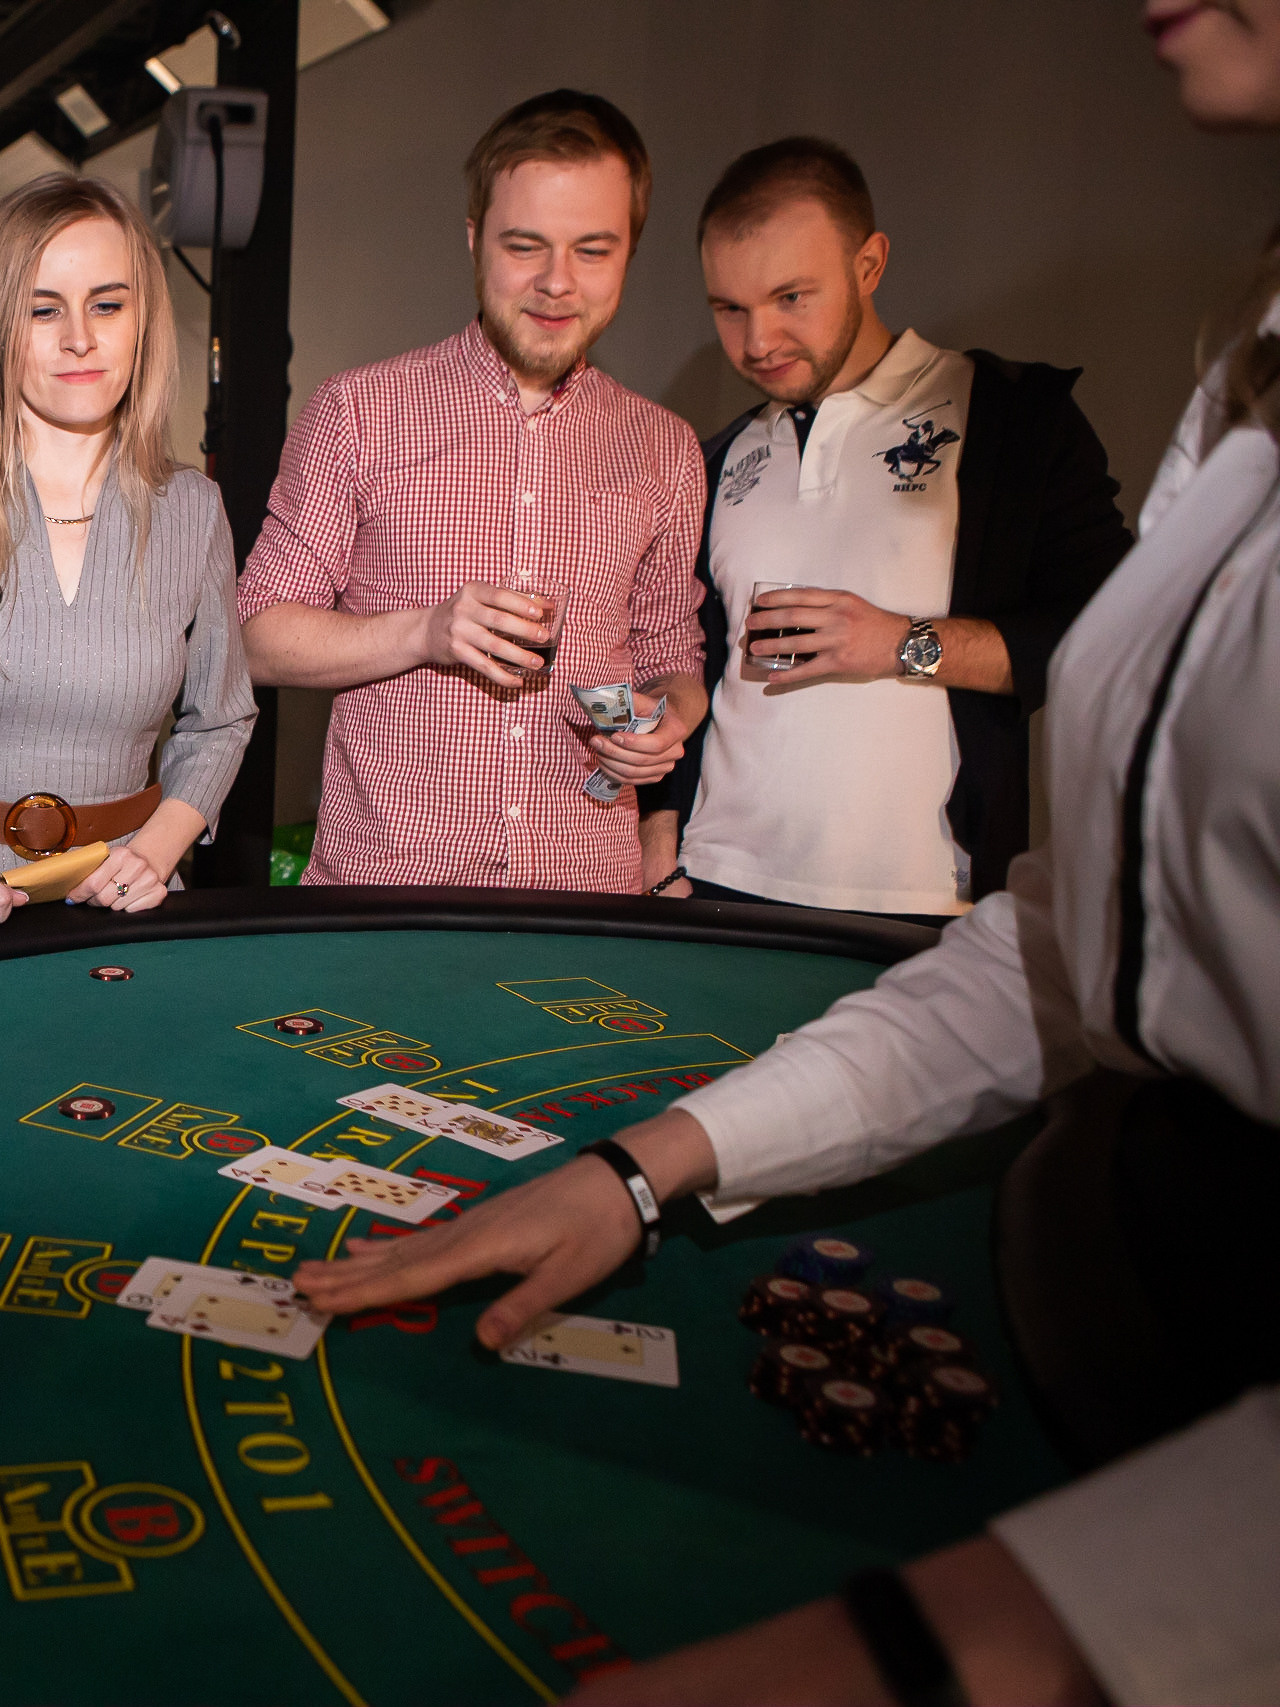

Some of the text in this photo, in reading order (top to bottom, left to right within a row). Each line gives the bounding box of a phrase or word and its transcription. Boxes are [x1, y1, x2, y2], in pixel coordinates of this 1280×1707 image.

[383, 1054, 428, 1070] B
[207, 1132, 257, 1152] B
[104, 1503, 180, 1542] B
[392, 1456, 632, 1685] SWITCH
